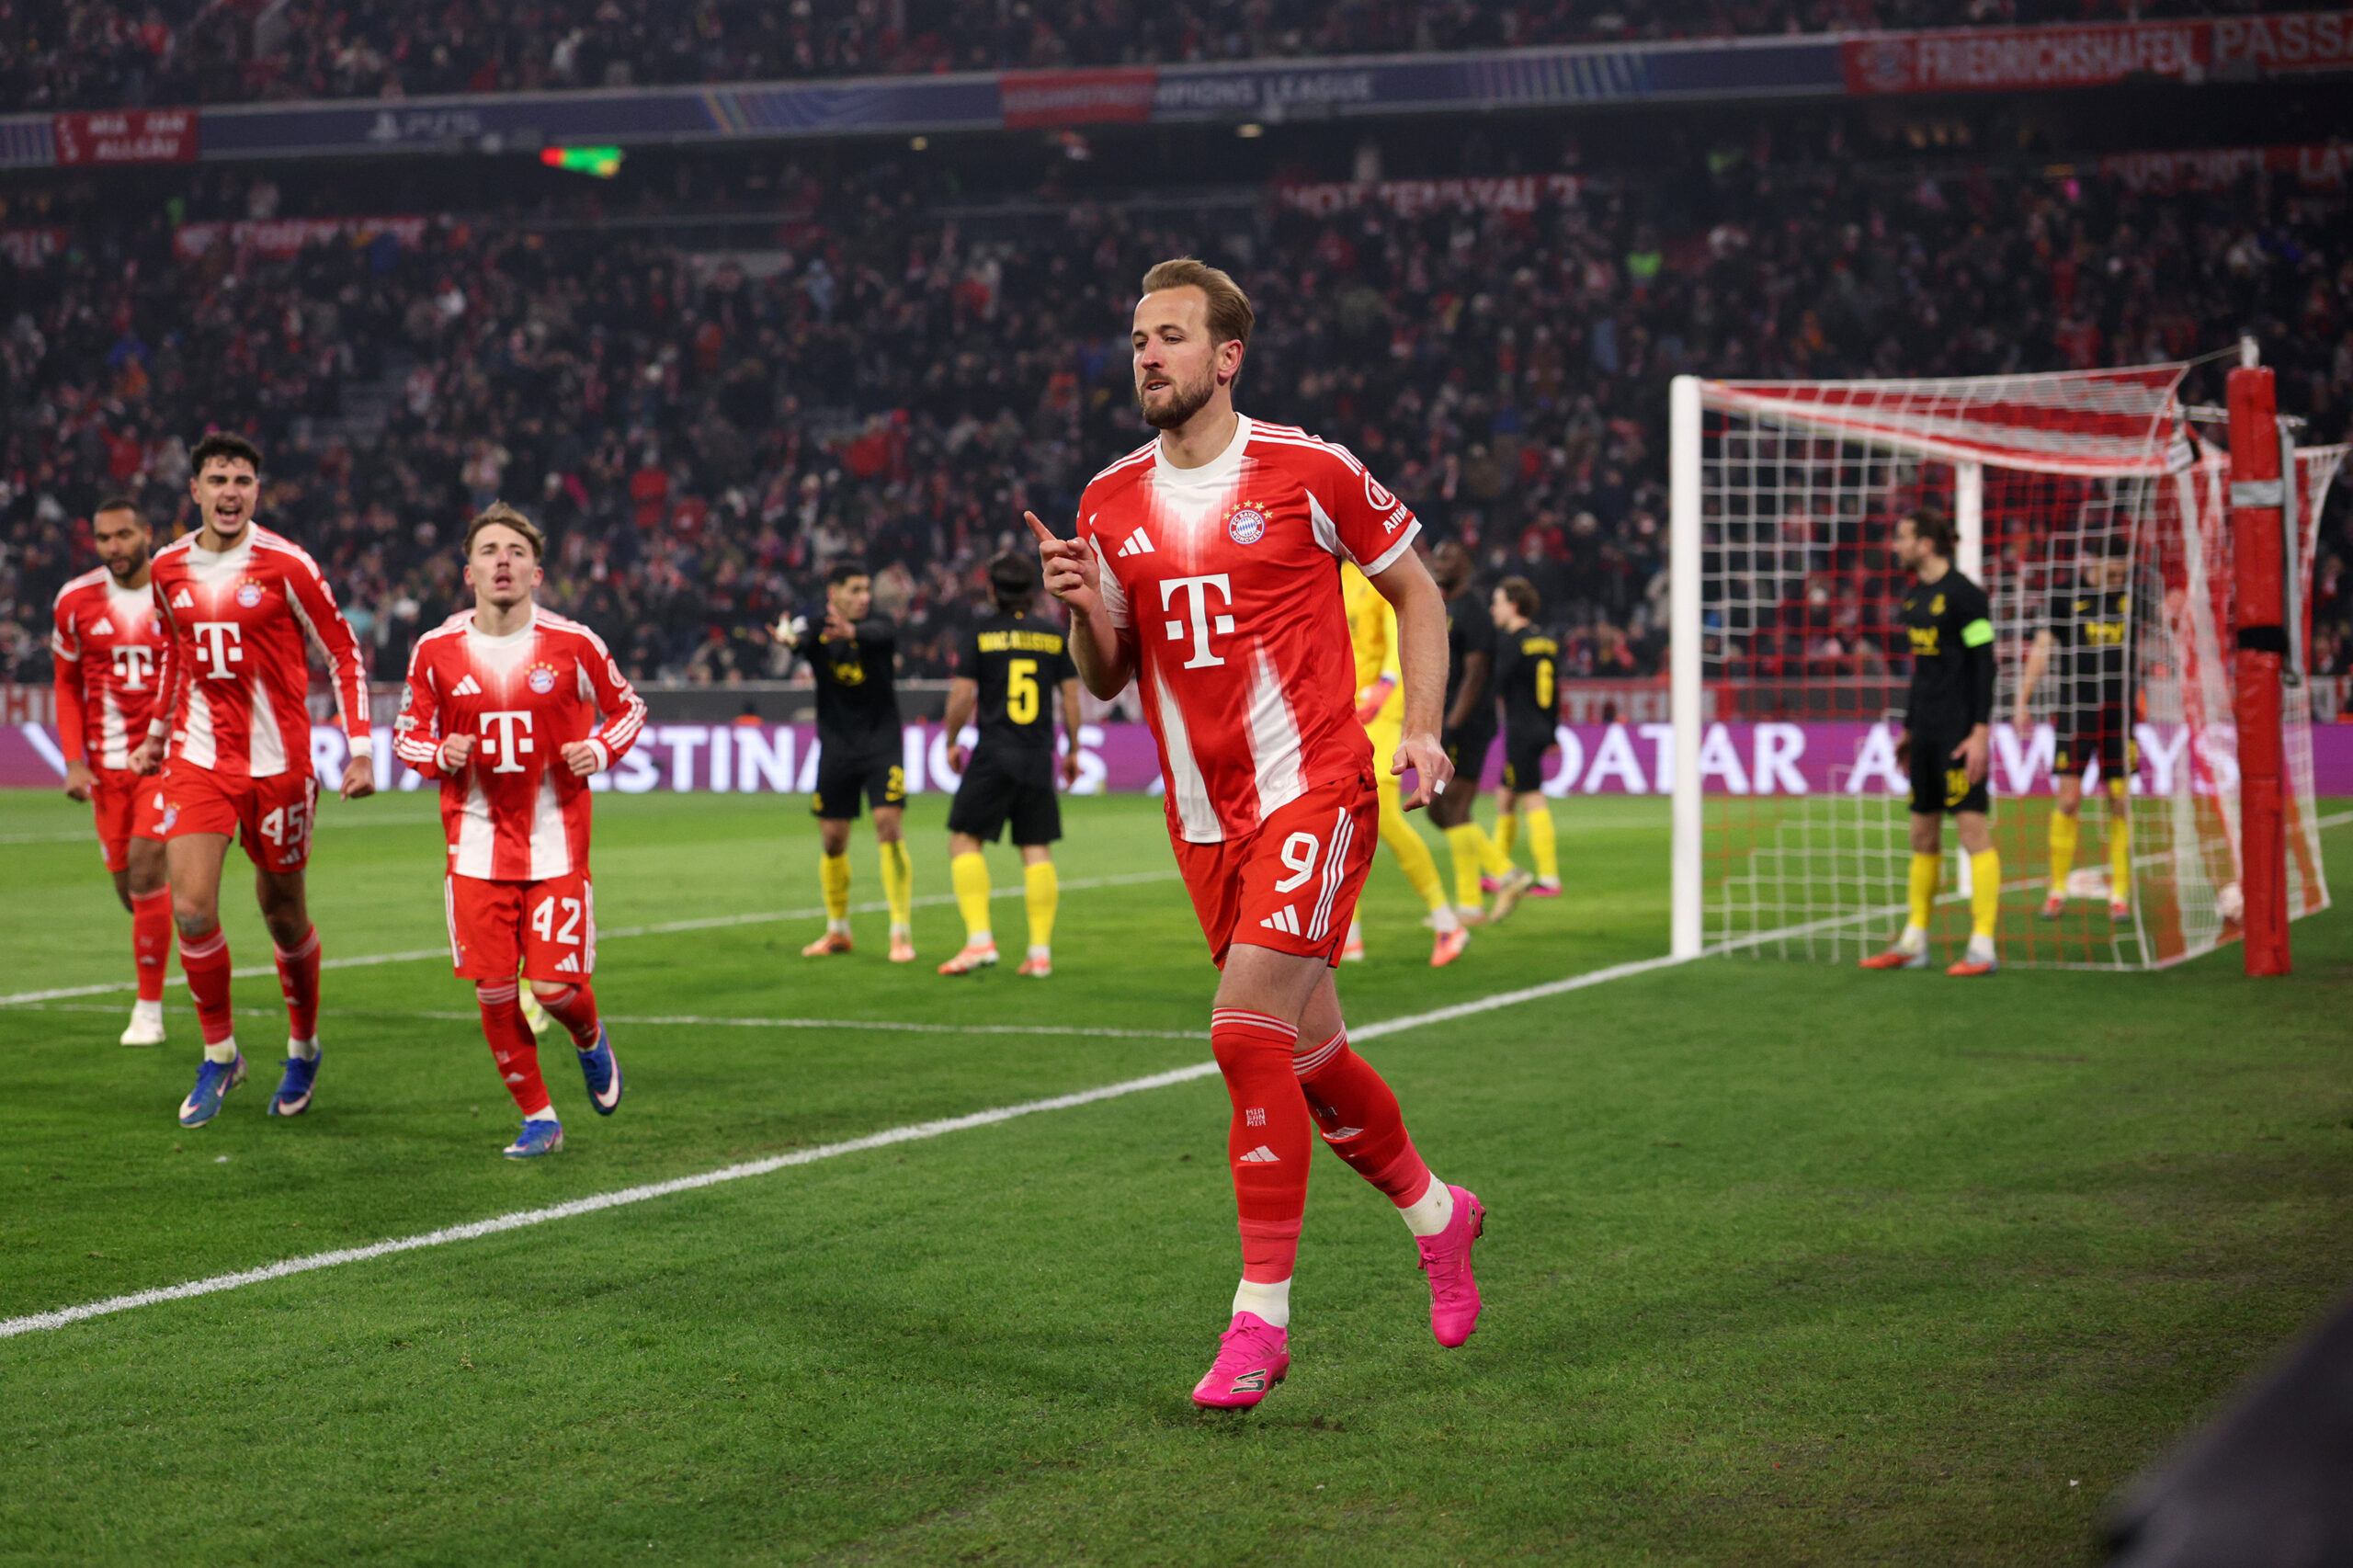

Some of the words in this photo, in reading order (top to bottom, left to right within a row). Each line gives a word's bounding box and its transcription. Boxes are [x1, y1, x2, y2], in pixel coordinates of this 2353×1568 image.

[1919, 25, 2195, 85] FRIEDRICHSHAFEN
[2215, 17, 2353, 61] PASS
[1239, 512, 1262, 526] BAYERN
[1159, 574, 1234, 669] T
[111, 644, 154, 689] T
[193, 622, 243, 679] T
[1006, 658, 1039, 725] 5
[1536, 658, 1554, 709] 6
[479, 710, 534, 773] T
[1845, 722, 2241, 796] AWYS
[261, 801, 305, 846] 45
[1274, 831, 1320, 893] 9
[531, 895, 581, 946] 42
